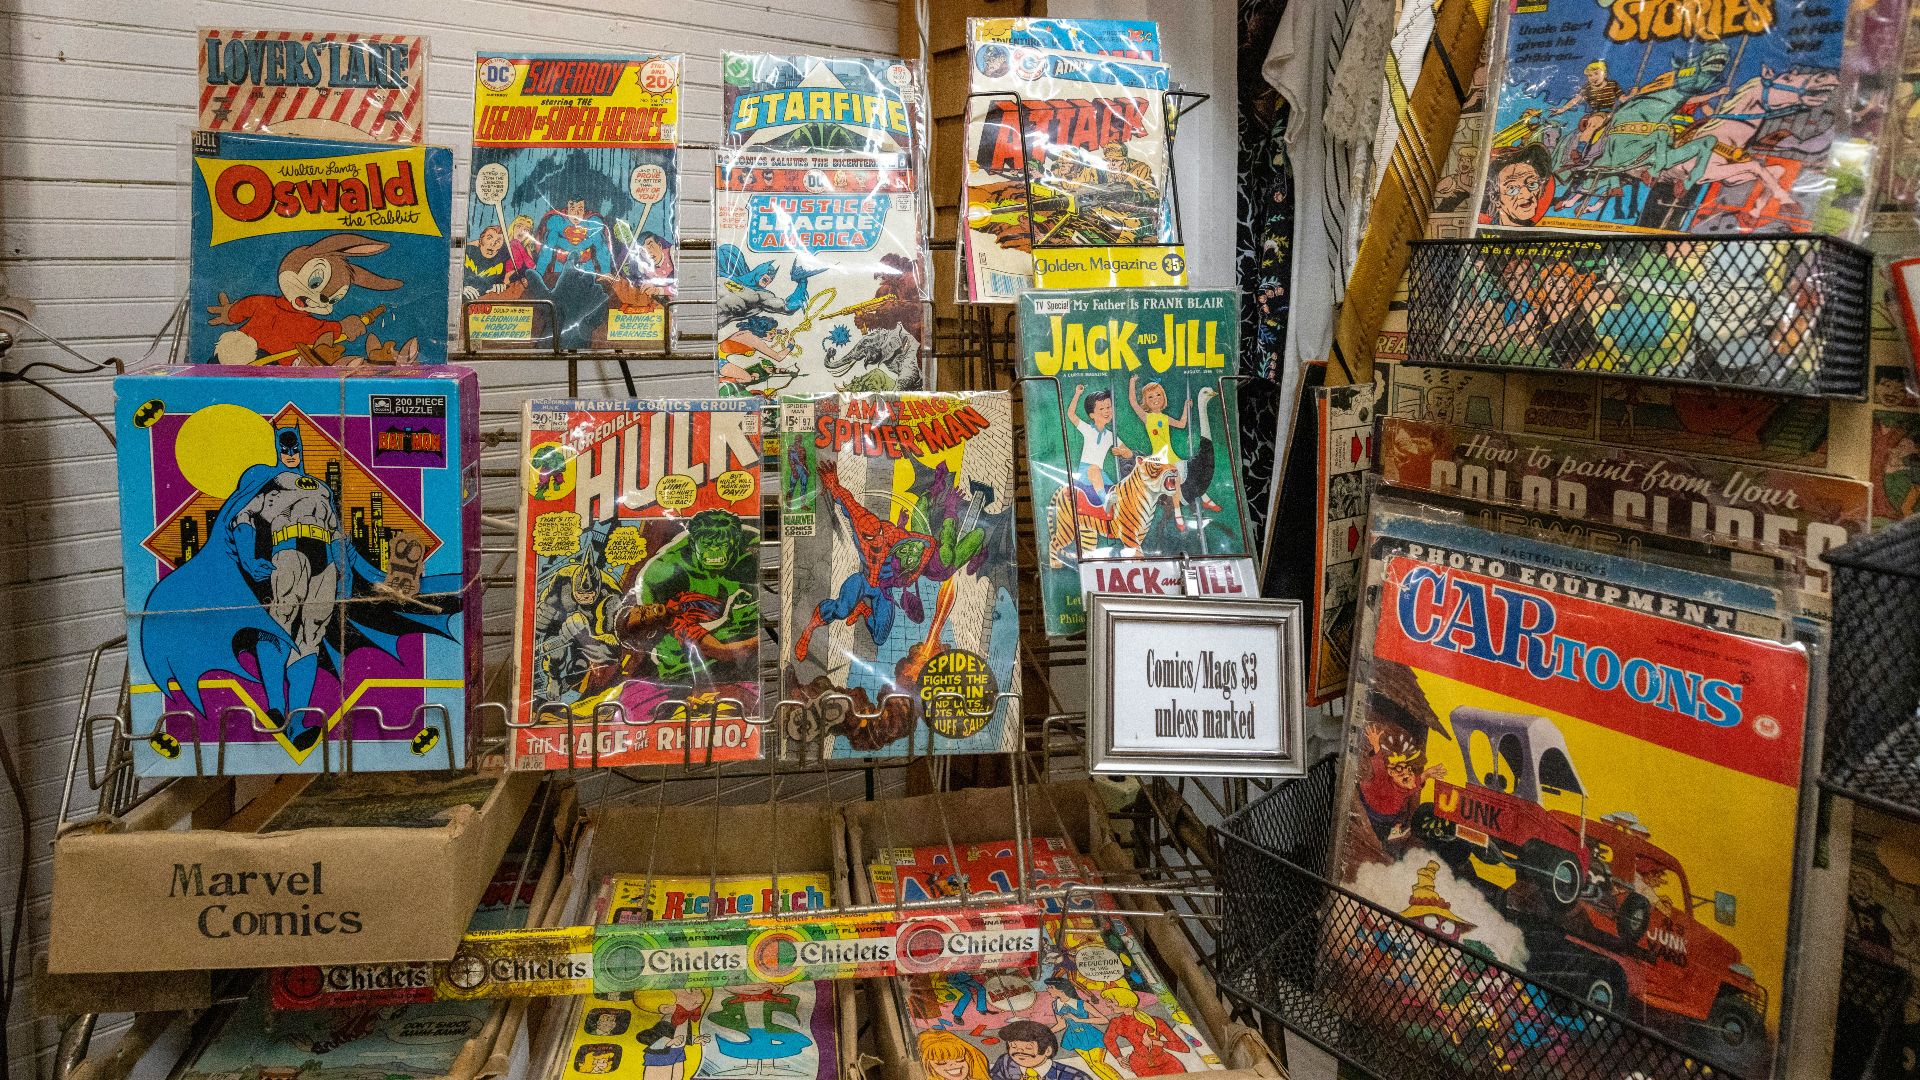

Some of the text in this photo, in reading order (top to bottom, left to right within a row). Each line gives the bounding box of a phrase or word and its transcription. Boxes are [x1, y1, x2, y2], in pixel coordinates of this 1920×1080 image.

[1518, 23, 1558, 36] Uncle
[1606, 0, 1777, 44] STORIES
[327, 41, 410, 89] LANE
[487, 65, 509, 83] DC
[524, 61, 627, 95] SUPERBOY
[540, 98, 593, 108] starring THE
[735, 90, 909, 134] STARFIRE
[475, 105, 538, 141] LEGION
[984, 97, 1150, 172] ATTACK
[278, 161, 362, 177] Walter Lantz
[770, 157, 808, 168] SALUTES
[811, 157, 829, 168] THE
[214, 159, 419, 223] Oswald
[759, 197, 877, 214] JUSTICE
[337, 210, 421, 227] the Rabbit
[752, 231, 867, 248] of AMERICA
[1034, 256, 1158, 275] Golden Magazine
[1035, 300, 1069, 311] TV Special!
[1092, 299, 1127, 311] Father
[1129, 299, 1140, 309] Is
[1143, 298, 1184, 310] FRANK
[1187, 298, 1224, 309] BLAIR
[480, 315, 532, 323] LEGIONNAIRE
[484, 323, 519, 331] NOBODY
[613, 314, 663, 323] BRAINIAC'S
[619, 322, 655, 330] SECRET
[609, 330, 660, 338] WEAKNESS
[1034, 313, 1225, 377] JACK AND JILL
[395, 397, 444, 406] 200 PIECE
[395, 406, 433, 414] PUZZLE
[574, 400, 747, 411] MARVEL COMICS GROUP
[846, 398, 950, 422] AMAZING
[553, 412, 567, 420] 157
[785, 415, 799, 427] 15¢
[802, 417, 811, 426] 97
[575, 411, 760, 530] HULK
[1461, 433, 1802, 511] How to paint from Your
[722, 488, 748, 497] PAY!!
[783, 513, 815, 526] MARVEL
[1408, 543, 1507, 578] PHOTO
[1519, 569, 1736, 630] EQUIPMENT
[927, 652, 986, 674] SPIDEY
[922, 674, 989, 686] FIGHTS THE
[1146, 648, 1258, 701] Comics/Mags $3
[1154, 698, 1256, 740] unless marked
[526, 723, 751, 756] THE RAGE OF THE RHINO!
[1437, 791, 1503, 831] JUNK
[168, 860, 325, 898] Marvel
[661, 885, 826, 921] Richie Rich
[197, 902, 364, 939] Comics
[841, 926, 887, 935] FLAVORS
[1646, 926, 1690, 954] JUNK
[800, 942, 891, 965] Chiclets
[947, 933, 1035, 955] Chiclets
[490, 957, 588, 982] Chiclets
[648, 949, 742, 974] Chiclets
[1078, 959, 1120, 968] REDUCTION
[326, 963, 428, 993] Chiclets
